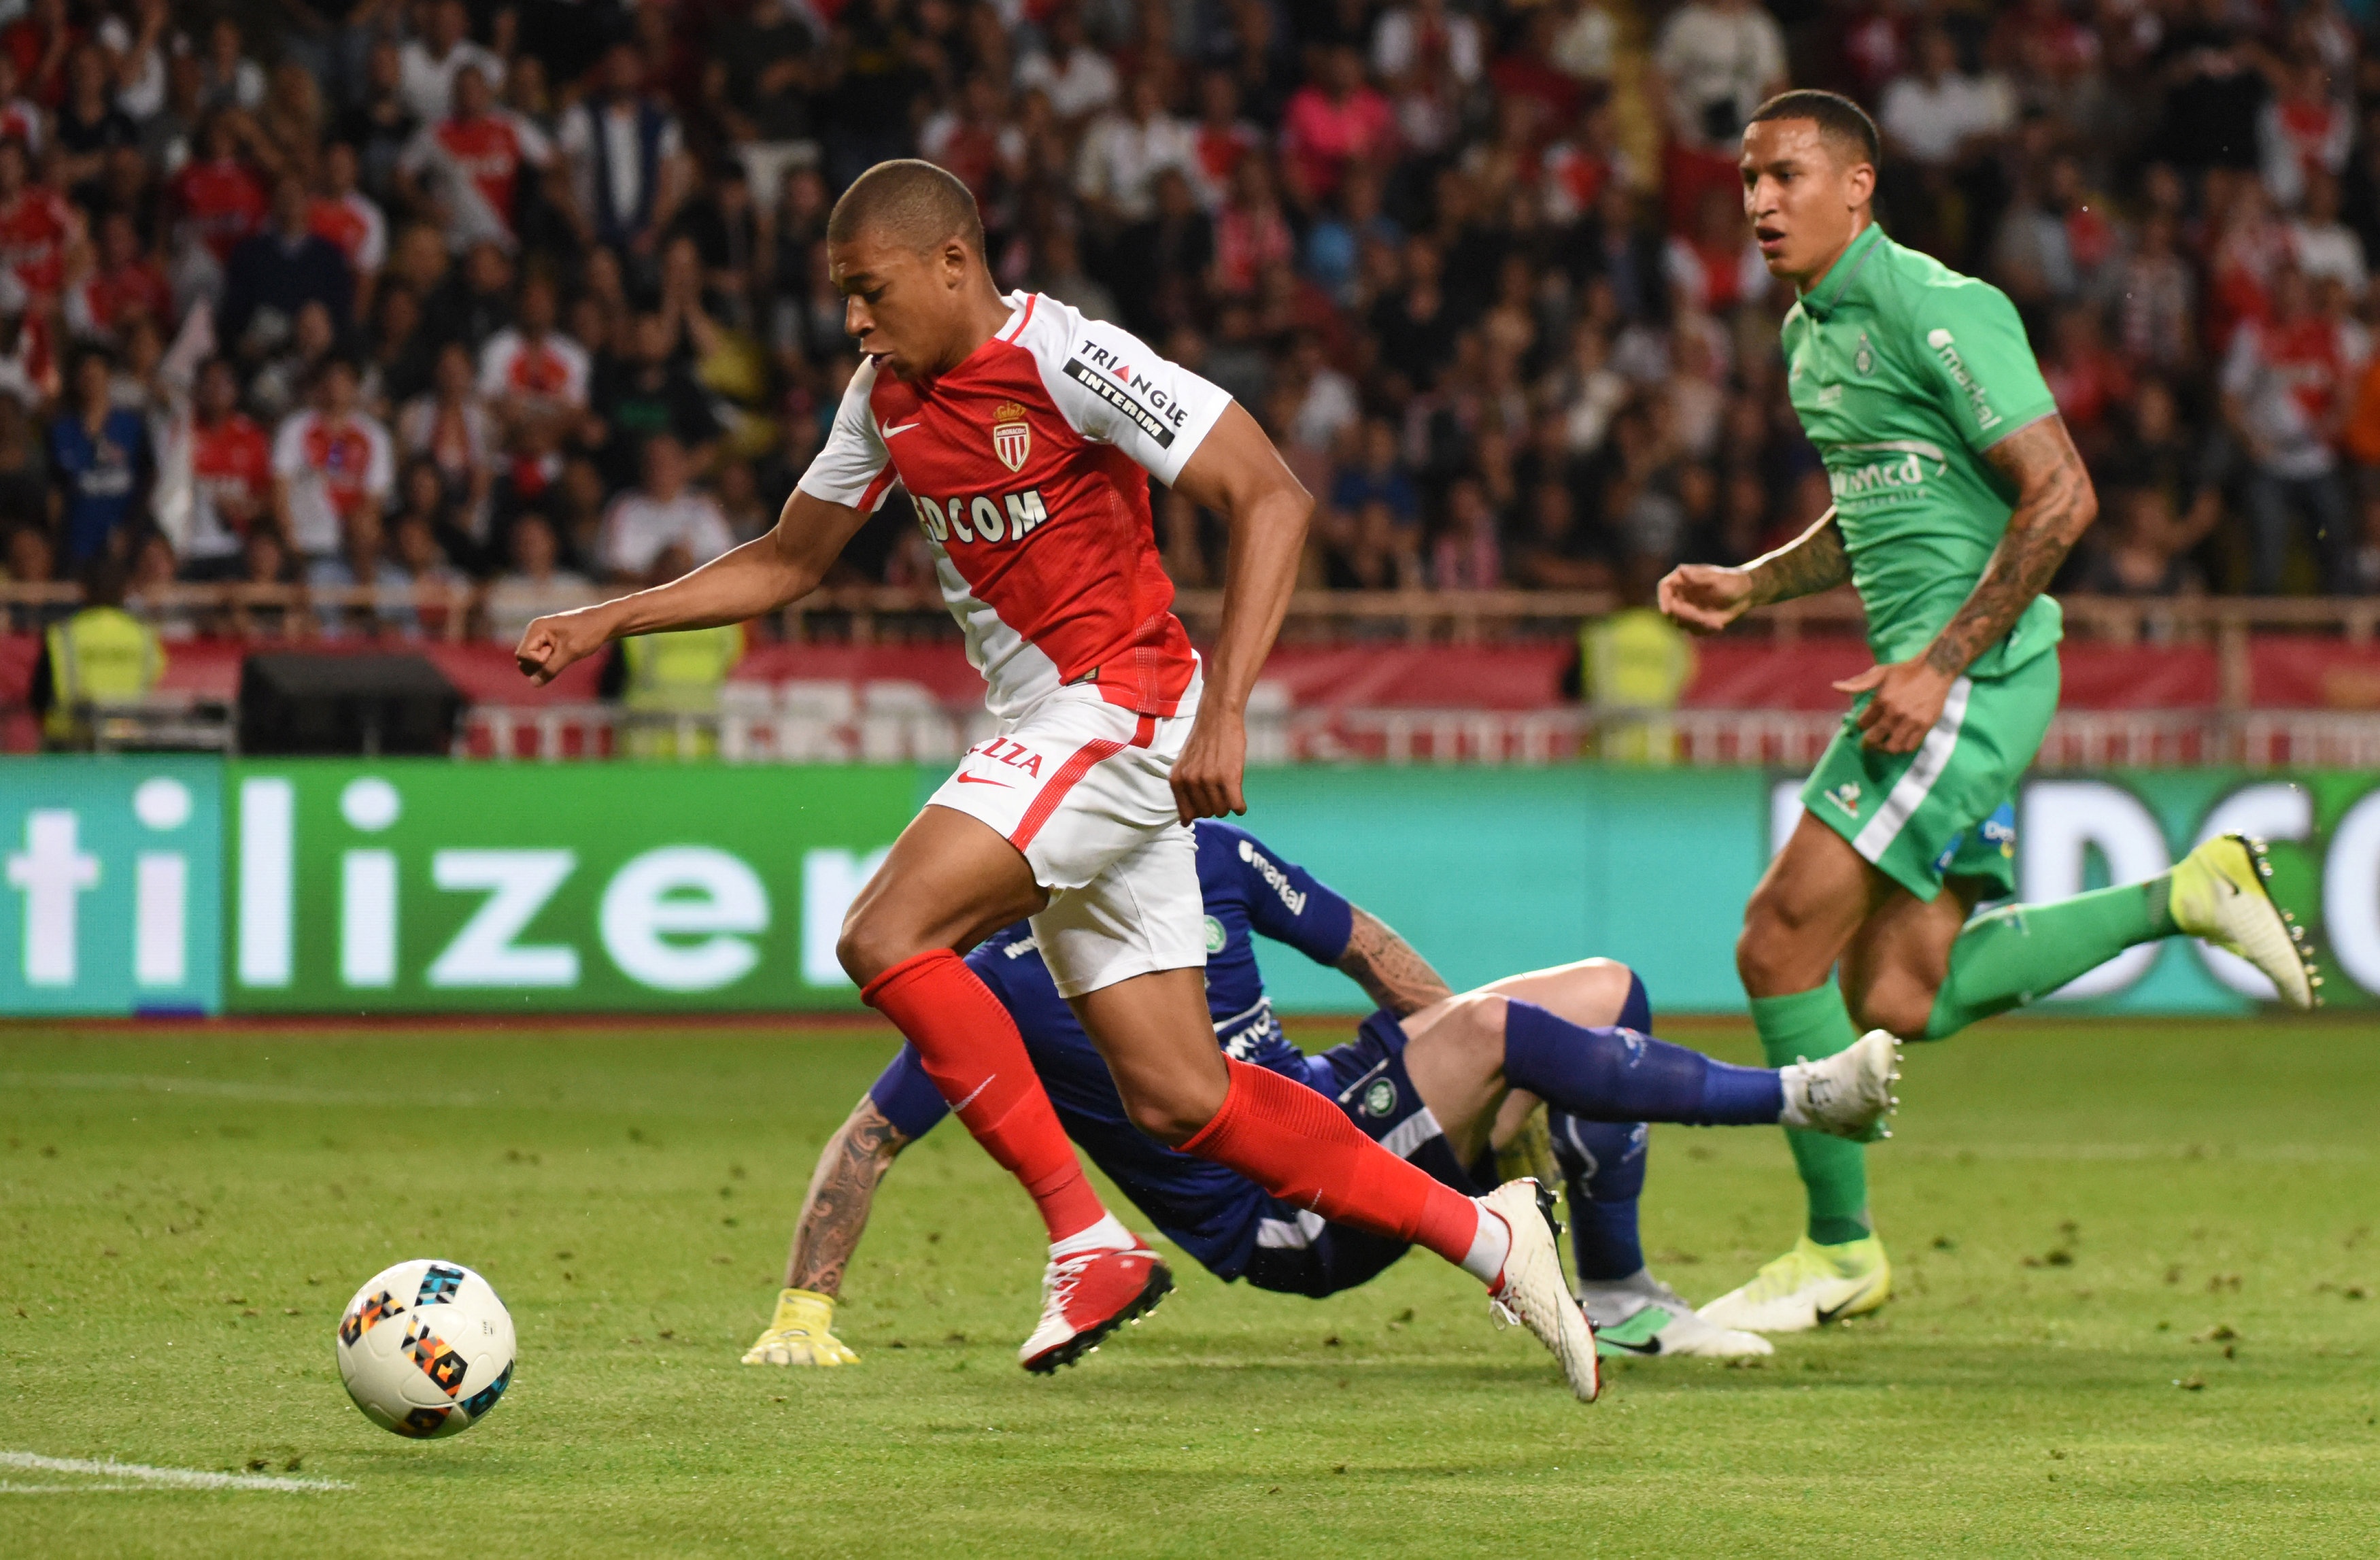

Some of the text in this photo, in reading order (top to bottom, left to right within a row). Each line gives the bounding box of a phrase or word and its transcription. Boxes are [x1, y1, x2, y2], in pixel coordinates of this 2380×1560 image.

[1078, 368, 1163, 437] INTERIM
[1081, 339, 1189, 428] TRIANGLE
[1252, 851, 1307, 916] markal
